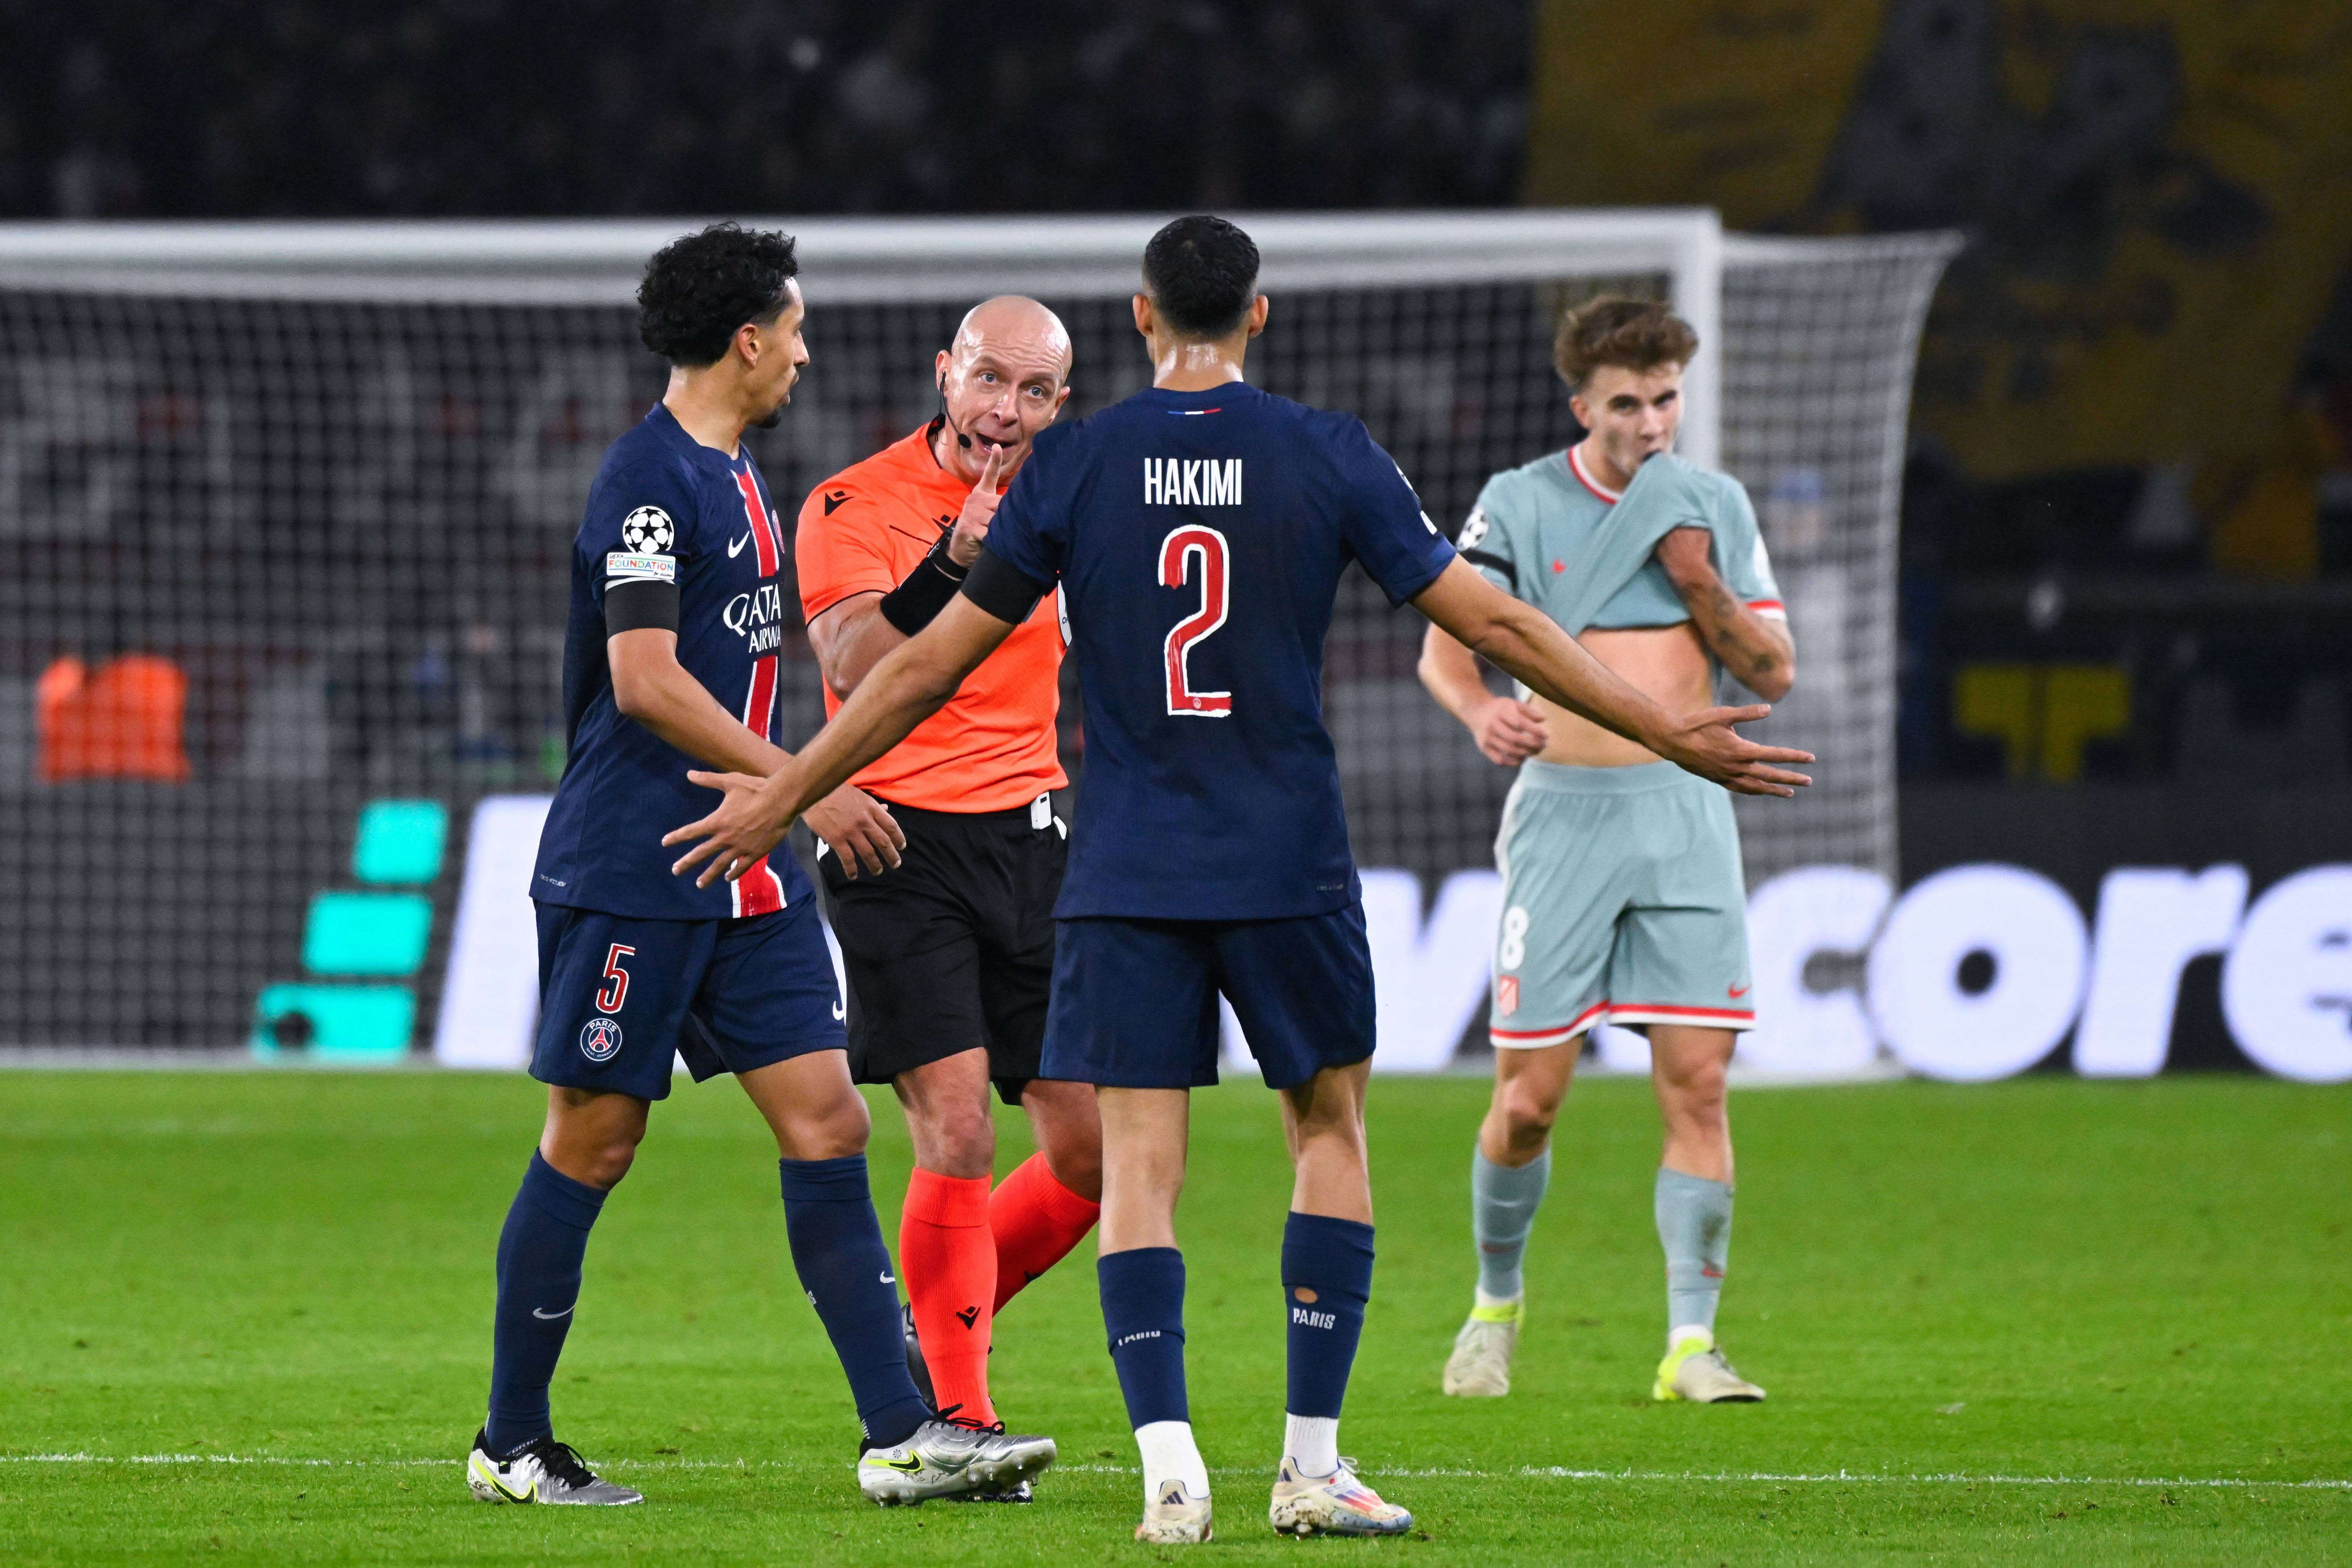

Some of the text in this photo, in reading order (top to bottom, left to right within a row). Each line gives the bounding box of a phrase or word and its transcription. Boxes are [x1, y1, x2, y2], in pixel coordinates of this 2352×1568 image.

[1144, 458, 1242, 506] HAKIMI
[723, 583, 781, 637] QATA
[1158, 524, 1232, 718] 2
[748, 624, 781, 653] AIRWA
[1500, 906, 1529, 971] 8
[596, 943, 636, 1014] 5
[589, 1021, 617, 1032] PARIS
[1293, 1308, 1336, 1329] PARIS
